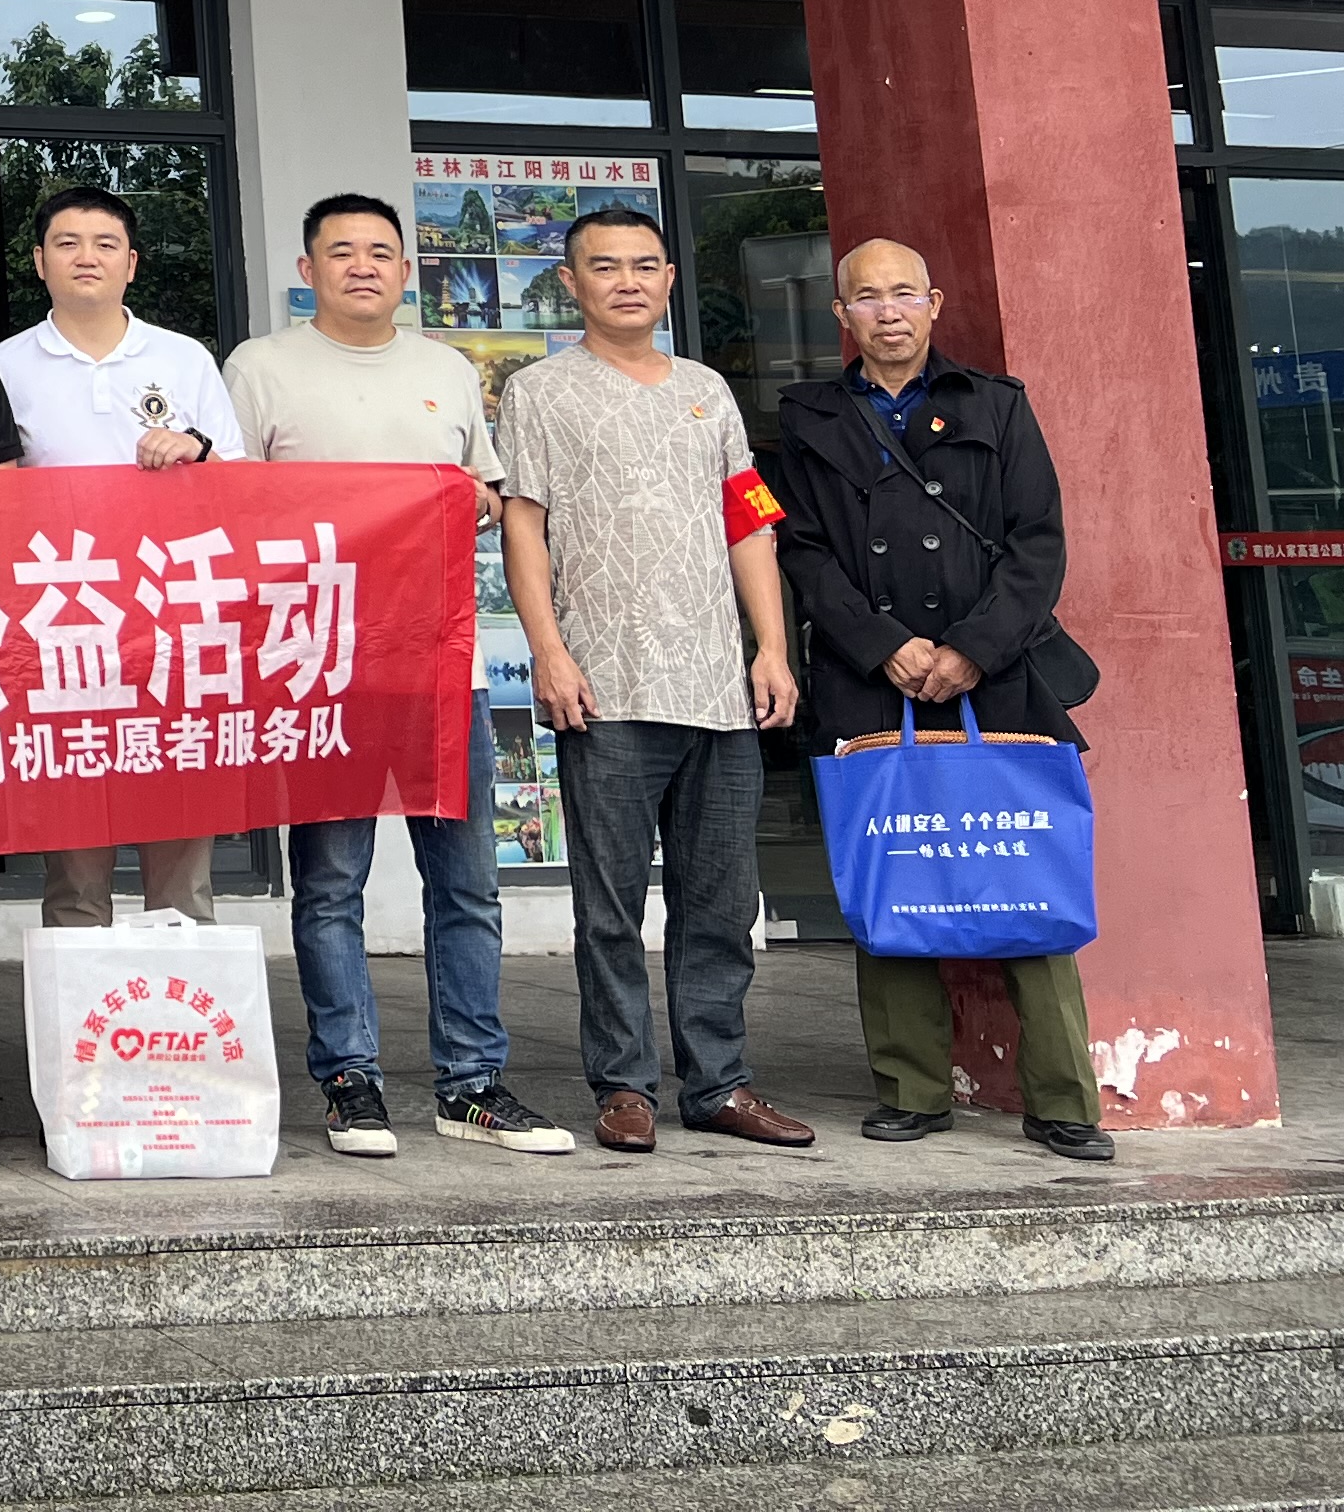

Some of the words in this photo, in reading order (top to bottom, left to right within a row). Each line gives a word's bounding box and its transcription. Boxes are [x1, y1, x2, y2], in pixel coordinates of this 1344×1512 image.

[415, 157, 650, 182] 桂林漓江阳朔山水图
[73, 975, 150, 1064] 情系车轮
[165, 975, 244, 1064] 夏送清凉
[147, 1031, 208, 1051] FTAF
